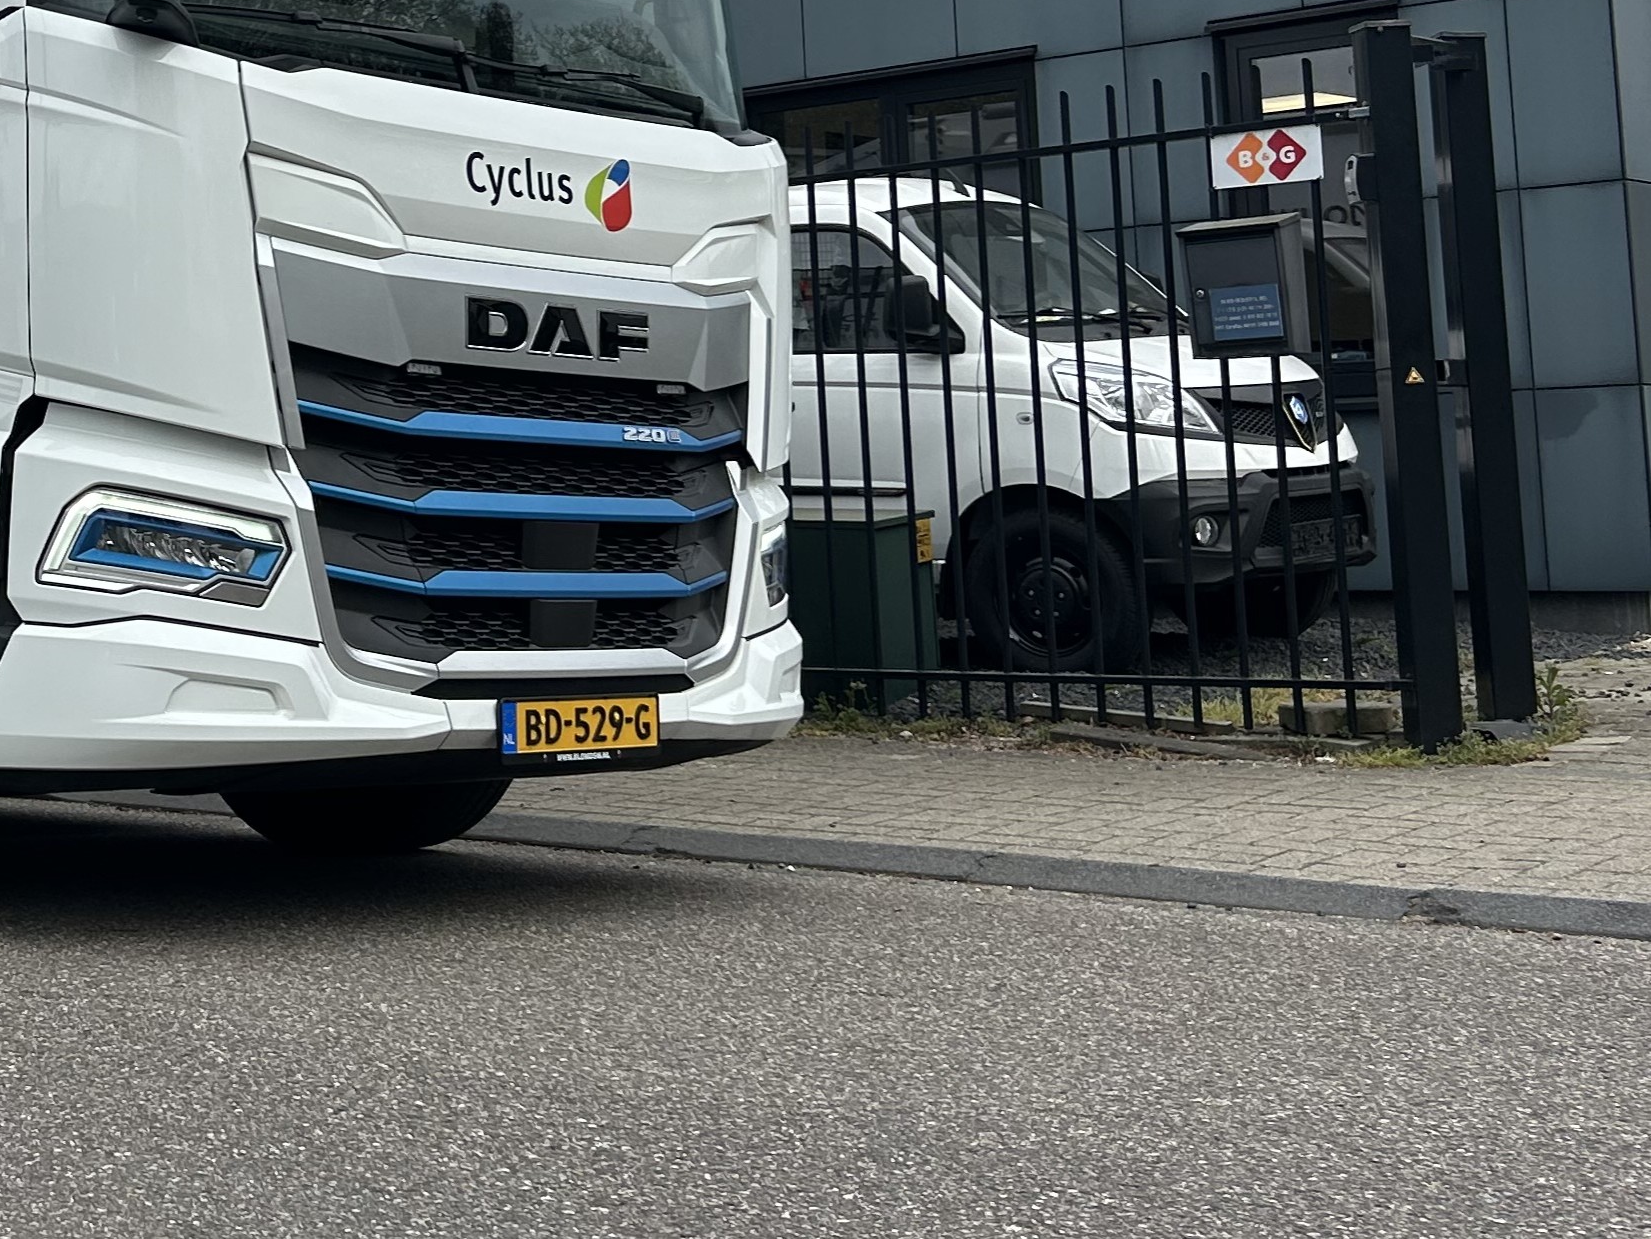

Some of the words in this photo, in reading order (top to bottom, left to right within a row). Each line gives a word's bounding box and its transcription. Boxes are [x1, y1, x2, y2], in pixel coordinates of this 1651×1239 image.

[466, 151, 573, 206] Cyclus
[465, 295, 649, 362] DAF
[503, 734, 515, 745] NL
[525, 704, 651, 746] BD-529-G
